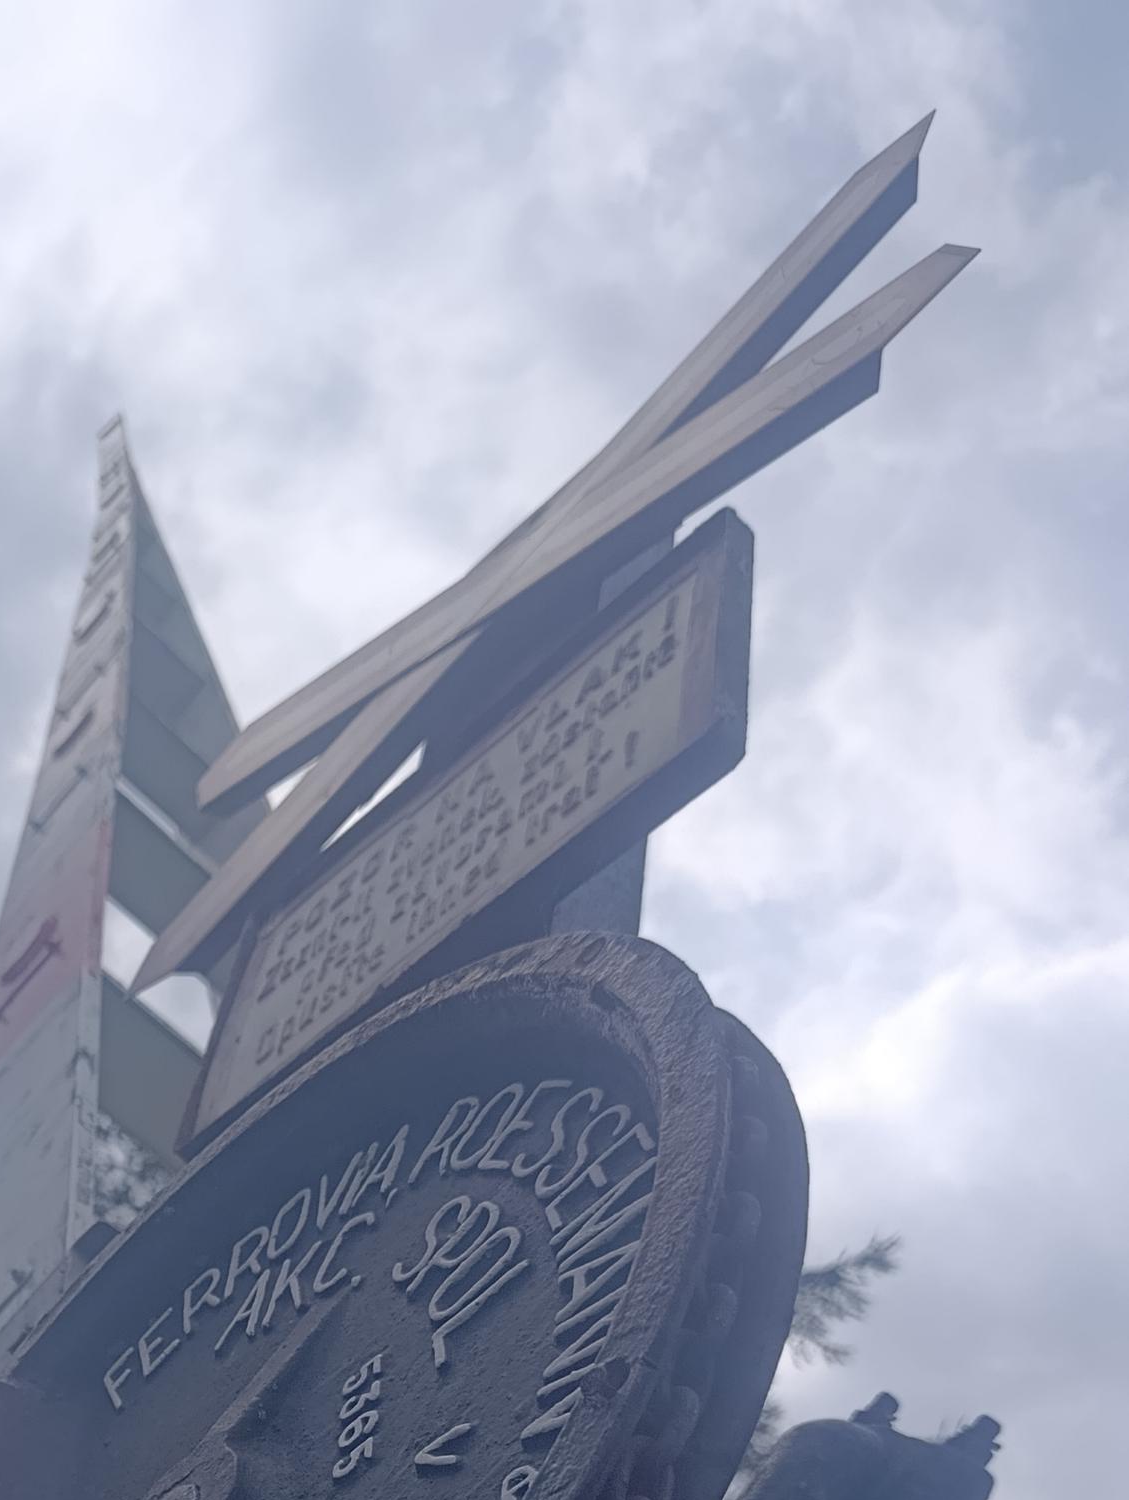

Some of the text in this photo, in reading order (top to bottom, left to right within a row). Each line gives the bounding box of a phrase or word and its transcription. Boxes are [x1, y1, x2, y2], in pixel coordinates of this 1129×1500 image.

[276, 822, 417, 956] POZOR
[433, 758, 495, 825] NA
[331, 1352, 383, 1479] 5365
